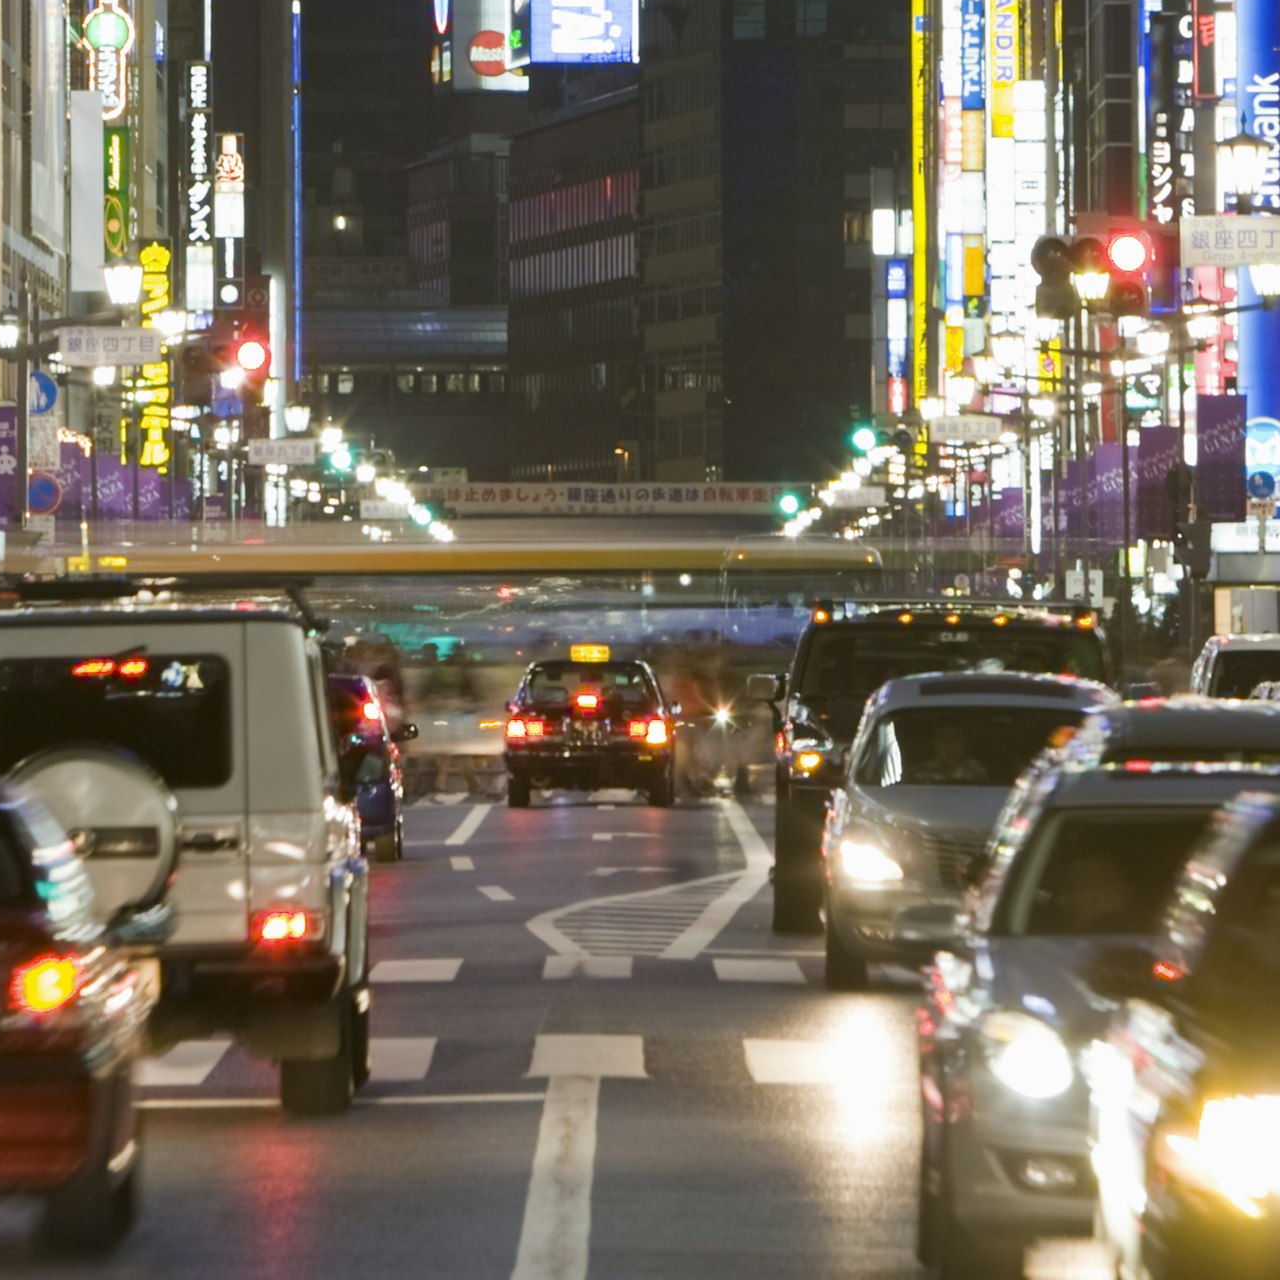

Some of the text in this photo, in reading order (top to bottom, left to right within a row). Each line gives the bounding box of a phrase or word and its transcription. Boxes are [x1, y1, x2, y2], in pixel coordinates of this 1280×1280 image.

[187, 180, 212, 242] ダンス
[1152, 141, 1173, 224] ヨシノヤ
[1203, 429, 1247, 455] GINZA
